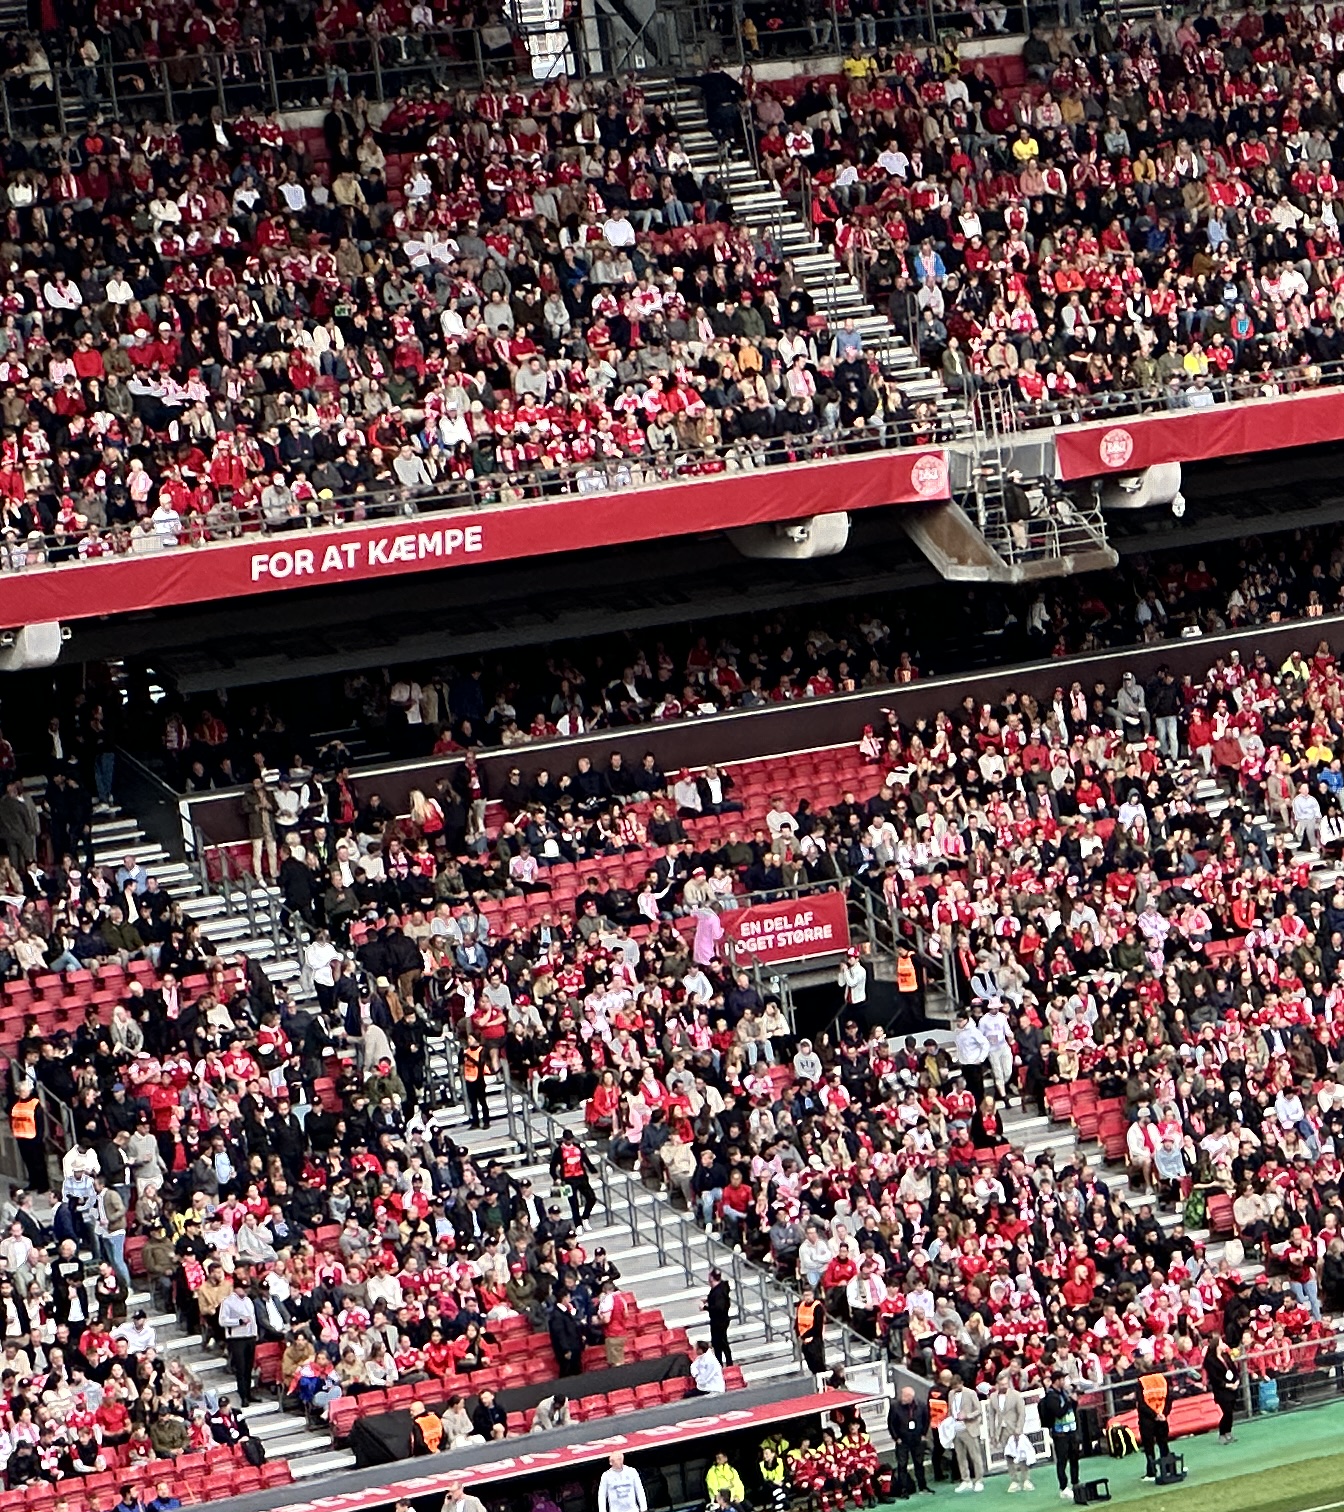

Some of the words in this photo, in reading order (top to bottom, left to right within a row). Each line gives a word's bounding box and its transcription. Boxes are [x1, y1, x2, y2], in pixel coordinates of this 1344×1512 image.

[251, 548, 315, 582] FOR
[320, 541, 362, 573] AT
[367, 525, 484, 567] KÆMPE
[740, 919, 762, 937] EN
[763, 914, 793, 934] DEL
[794, 911, 814, 927] AF
[776, 924, 833, 948] STØRRE
[639, 1410, 755, 1437] FOR
[567, 1434, 628, 1455] AT
